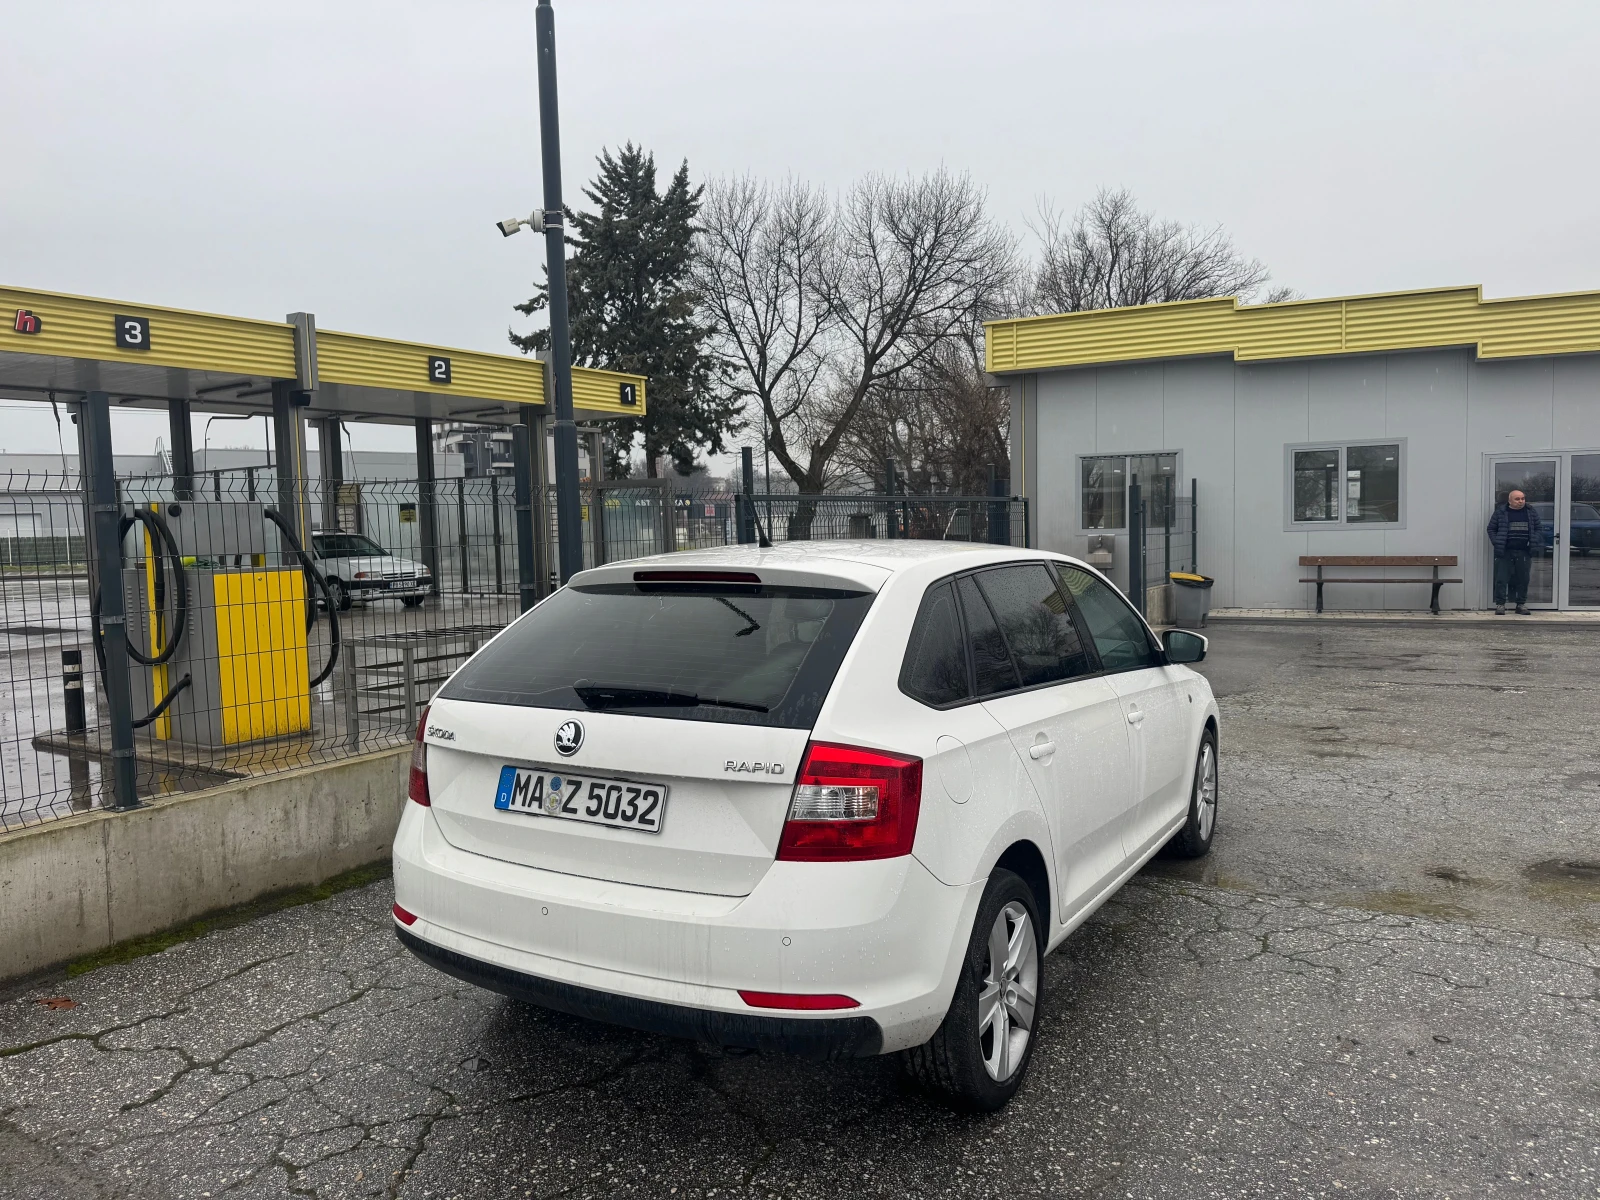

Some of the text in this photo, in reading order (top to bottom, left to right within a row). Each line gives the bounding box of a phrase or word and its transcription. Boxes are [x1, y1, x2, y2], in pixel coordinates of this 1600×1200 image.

[124, 321, 143, 344] 3
[434, 360, 447, 379] 2
[624, 386, 632, 402] 1
[724, 760, 785, 775] RAPID
[501, 792, 507, 802] D
[511, 773, 544, 809] MA
[561, 779, 583, 815] Z
[585, 782, 660, 826] 5032
